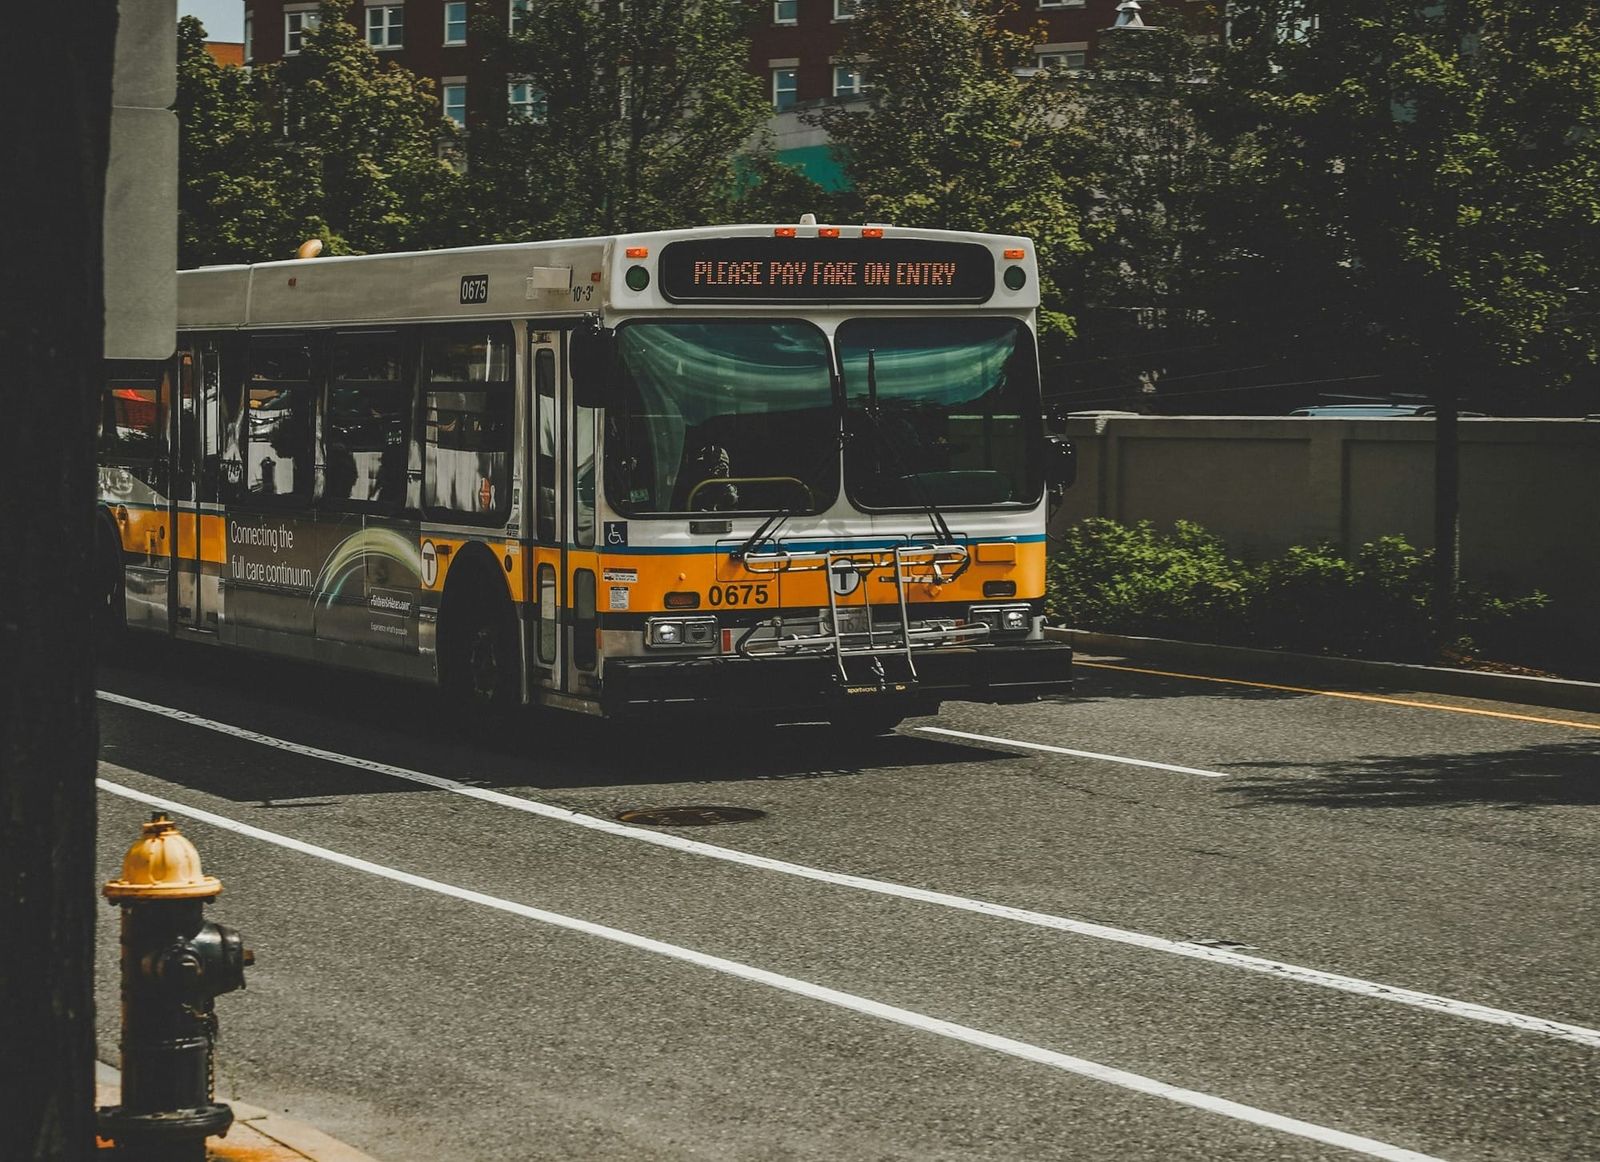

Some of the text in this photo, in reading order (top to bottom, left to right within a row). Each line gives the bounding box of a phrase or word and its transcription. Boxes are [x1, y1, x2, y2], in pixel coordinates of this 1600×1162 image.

[694, 261, 957, 285] PLEASE PAY FARE ON ENTRY
[462, 280, 487, 300] 0675
[230, 520, 294, 553] Connecting the
[232, 554, 314, 587] full care continuum.
[423, 552, 435, 581] T
[832, 566, 854, 590] T
[708, 584, 769, 606] 0675
